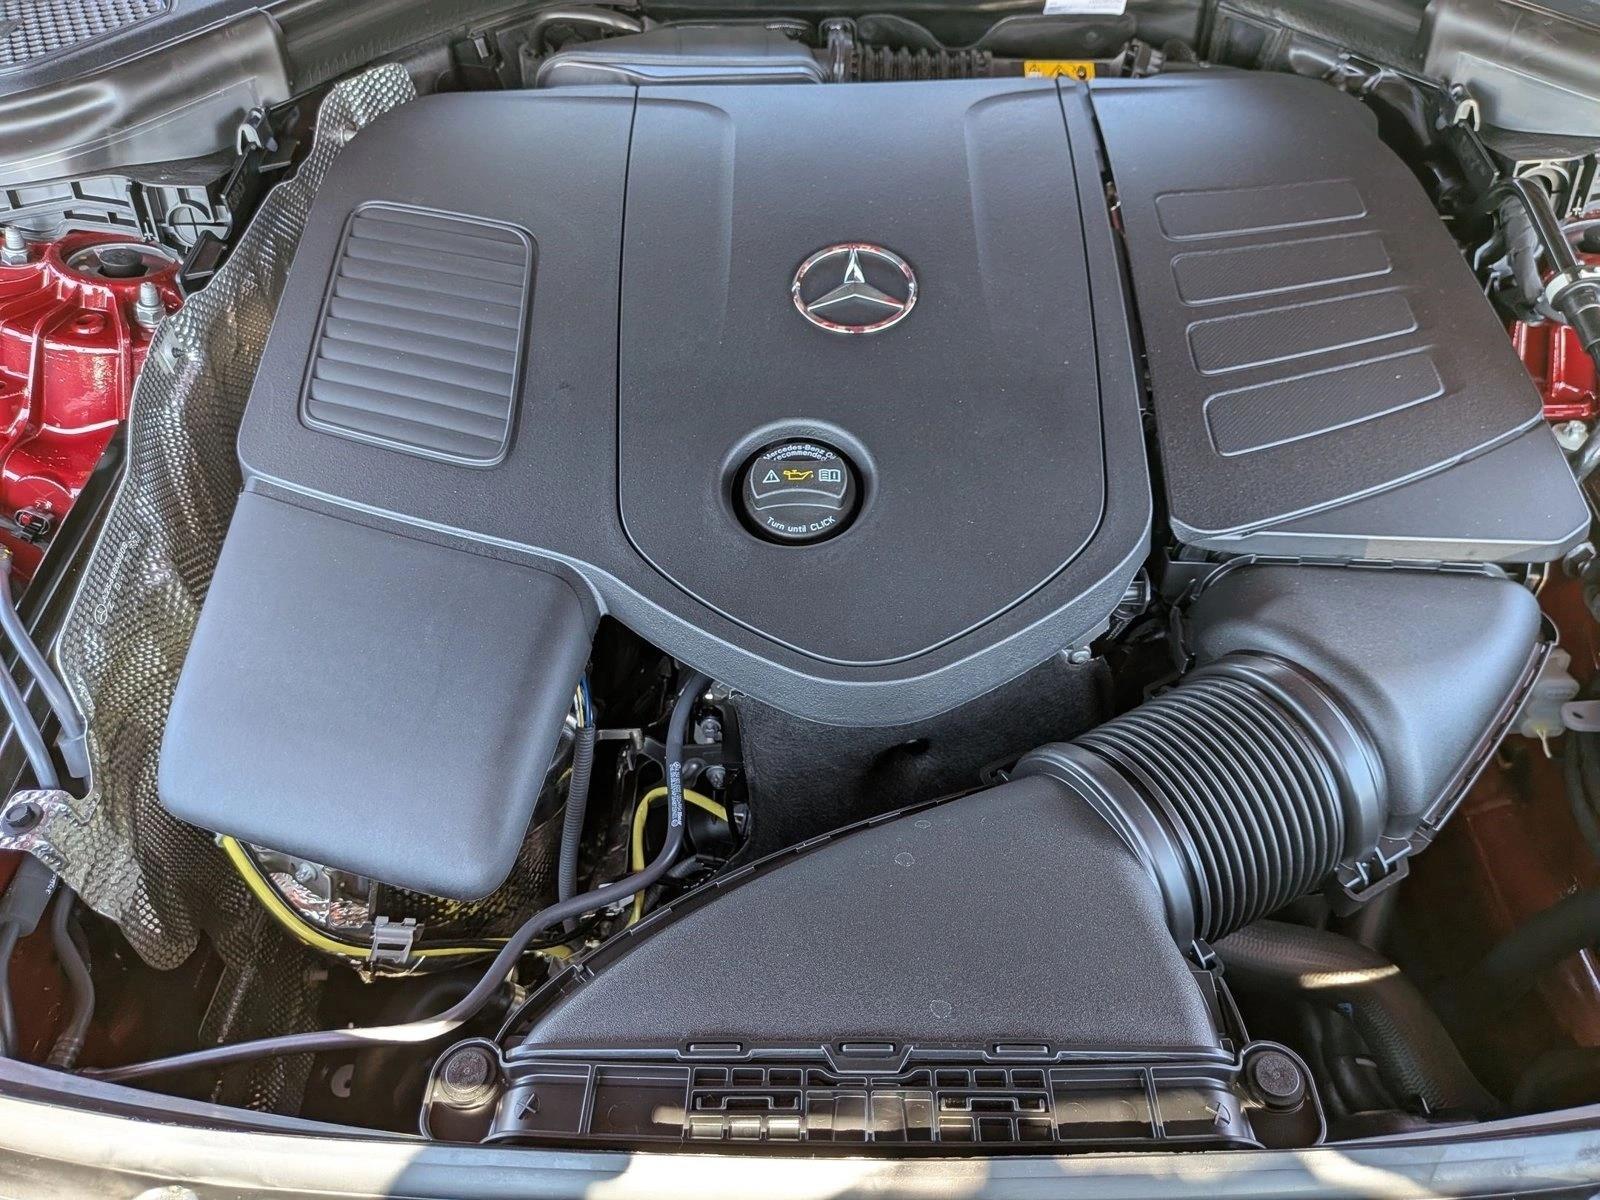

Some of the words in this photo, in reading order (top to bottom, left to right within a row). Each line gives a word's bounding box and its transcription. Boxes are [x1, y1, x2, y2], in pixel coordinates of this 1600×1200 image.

[763, 444, 825, 460] Mercedes-Benz
[773, 450, 828, 461] recommended
[767, 516, 785, 530] Turn
[787, 524, 807, 533] until
[810, 515, 836, 531] CLICK
